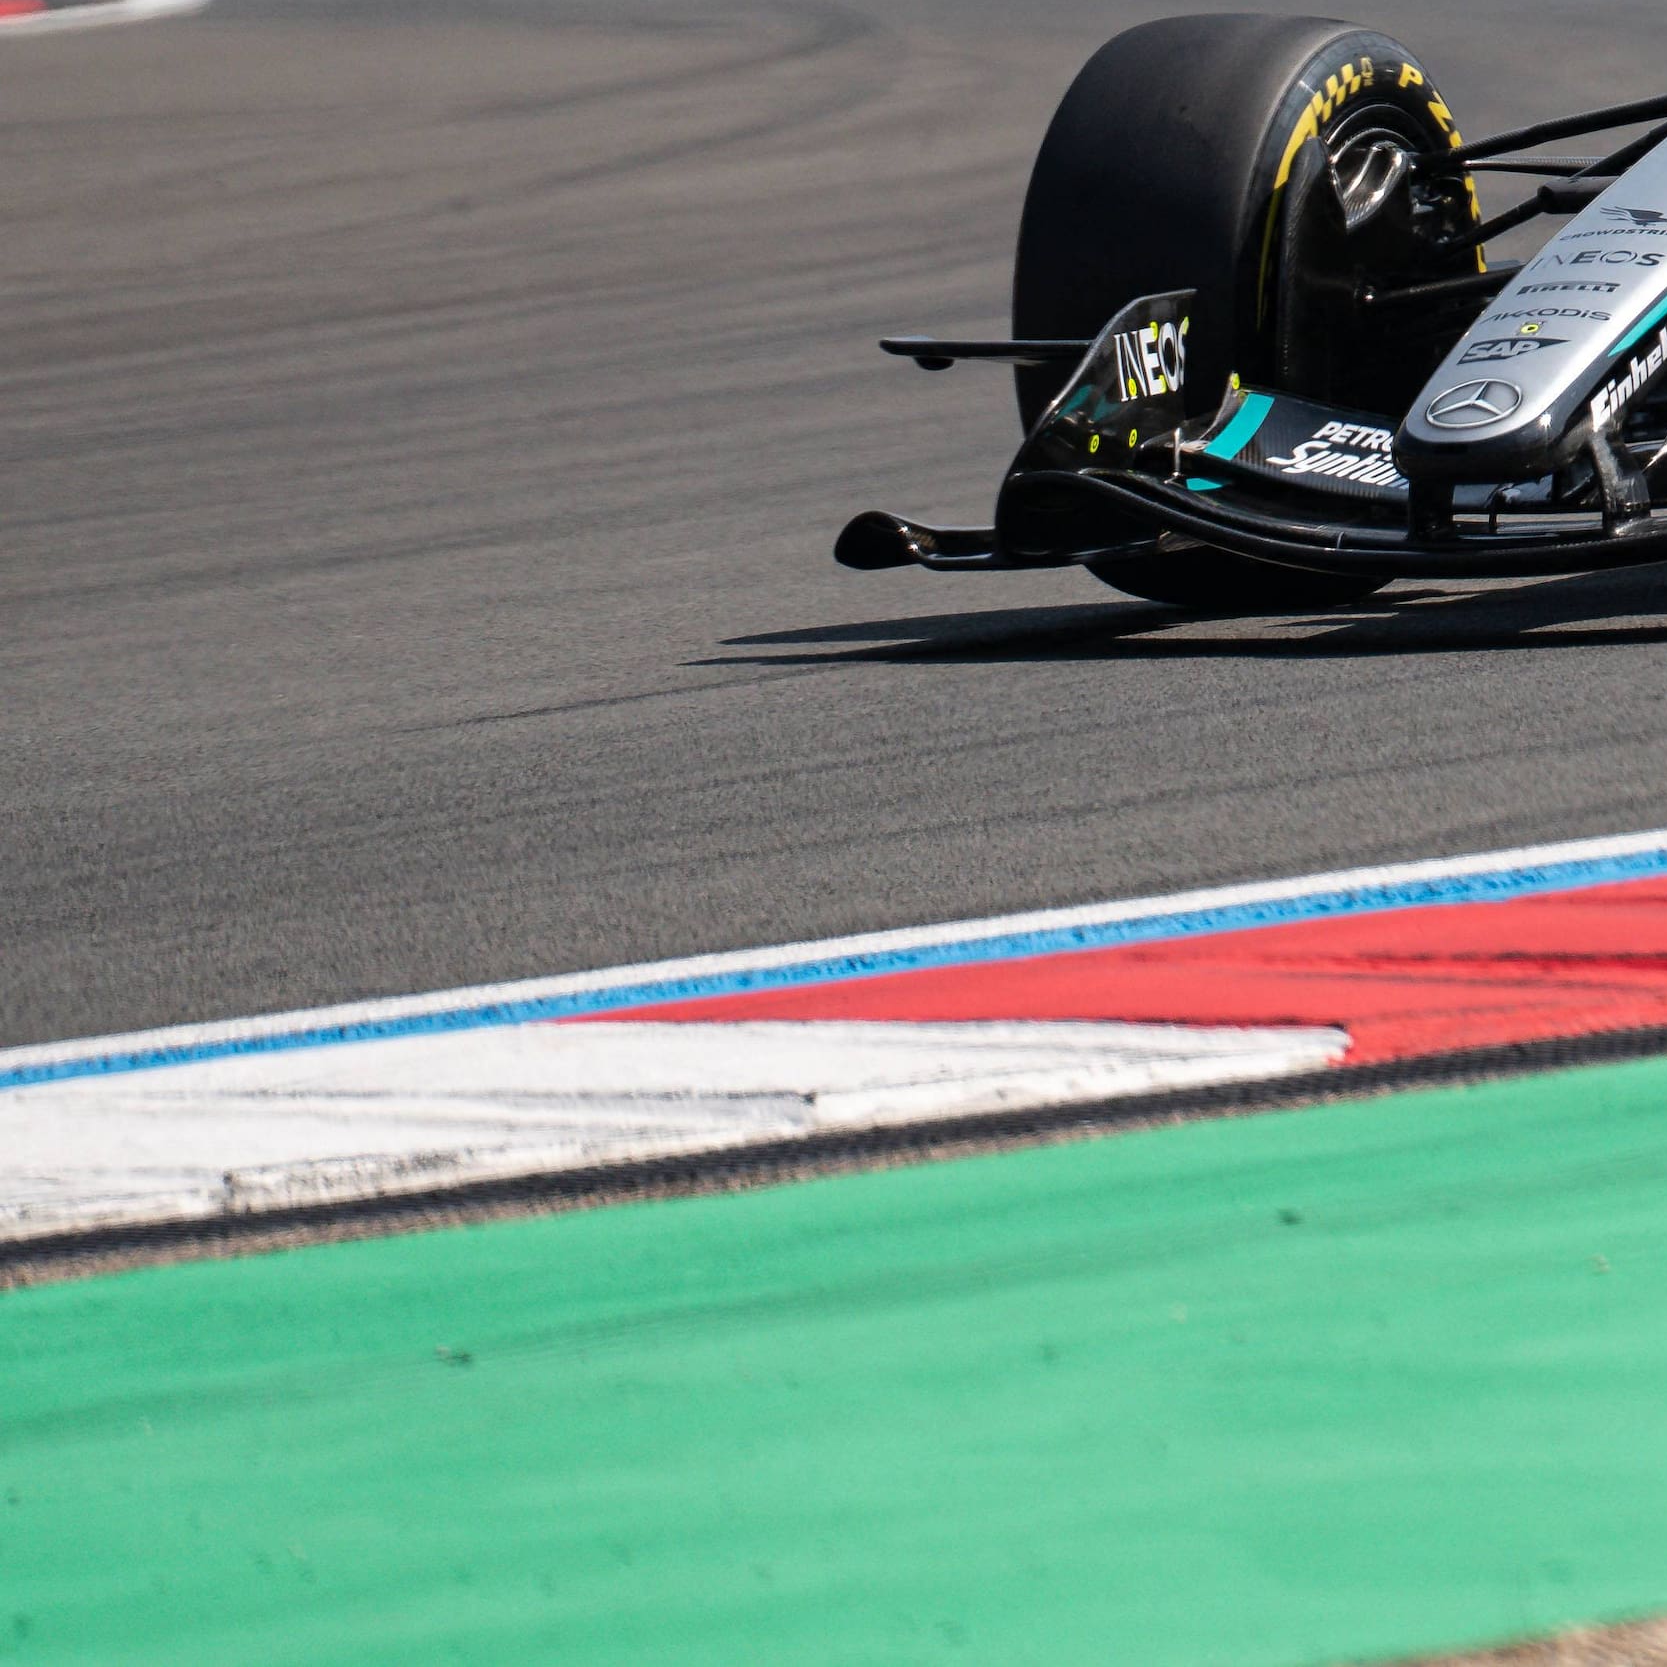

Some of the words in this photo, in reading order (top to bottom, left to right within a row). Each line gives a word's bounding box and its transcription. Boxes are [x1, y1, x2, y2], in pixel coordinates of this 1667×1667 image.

[1529, 250, 1665, 273] INEOS
[1516, 281, 1621, 295] PIRELLI
[1467, 340, 1542, 359] SAP
